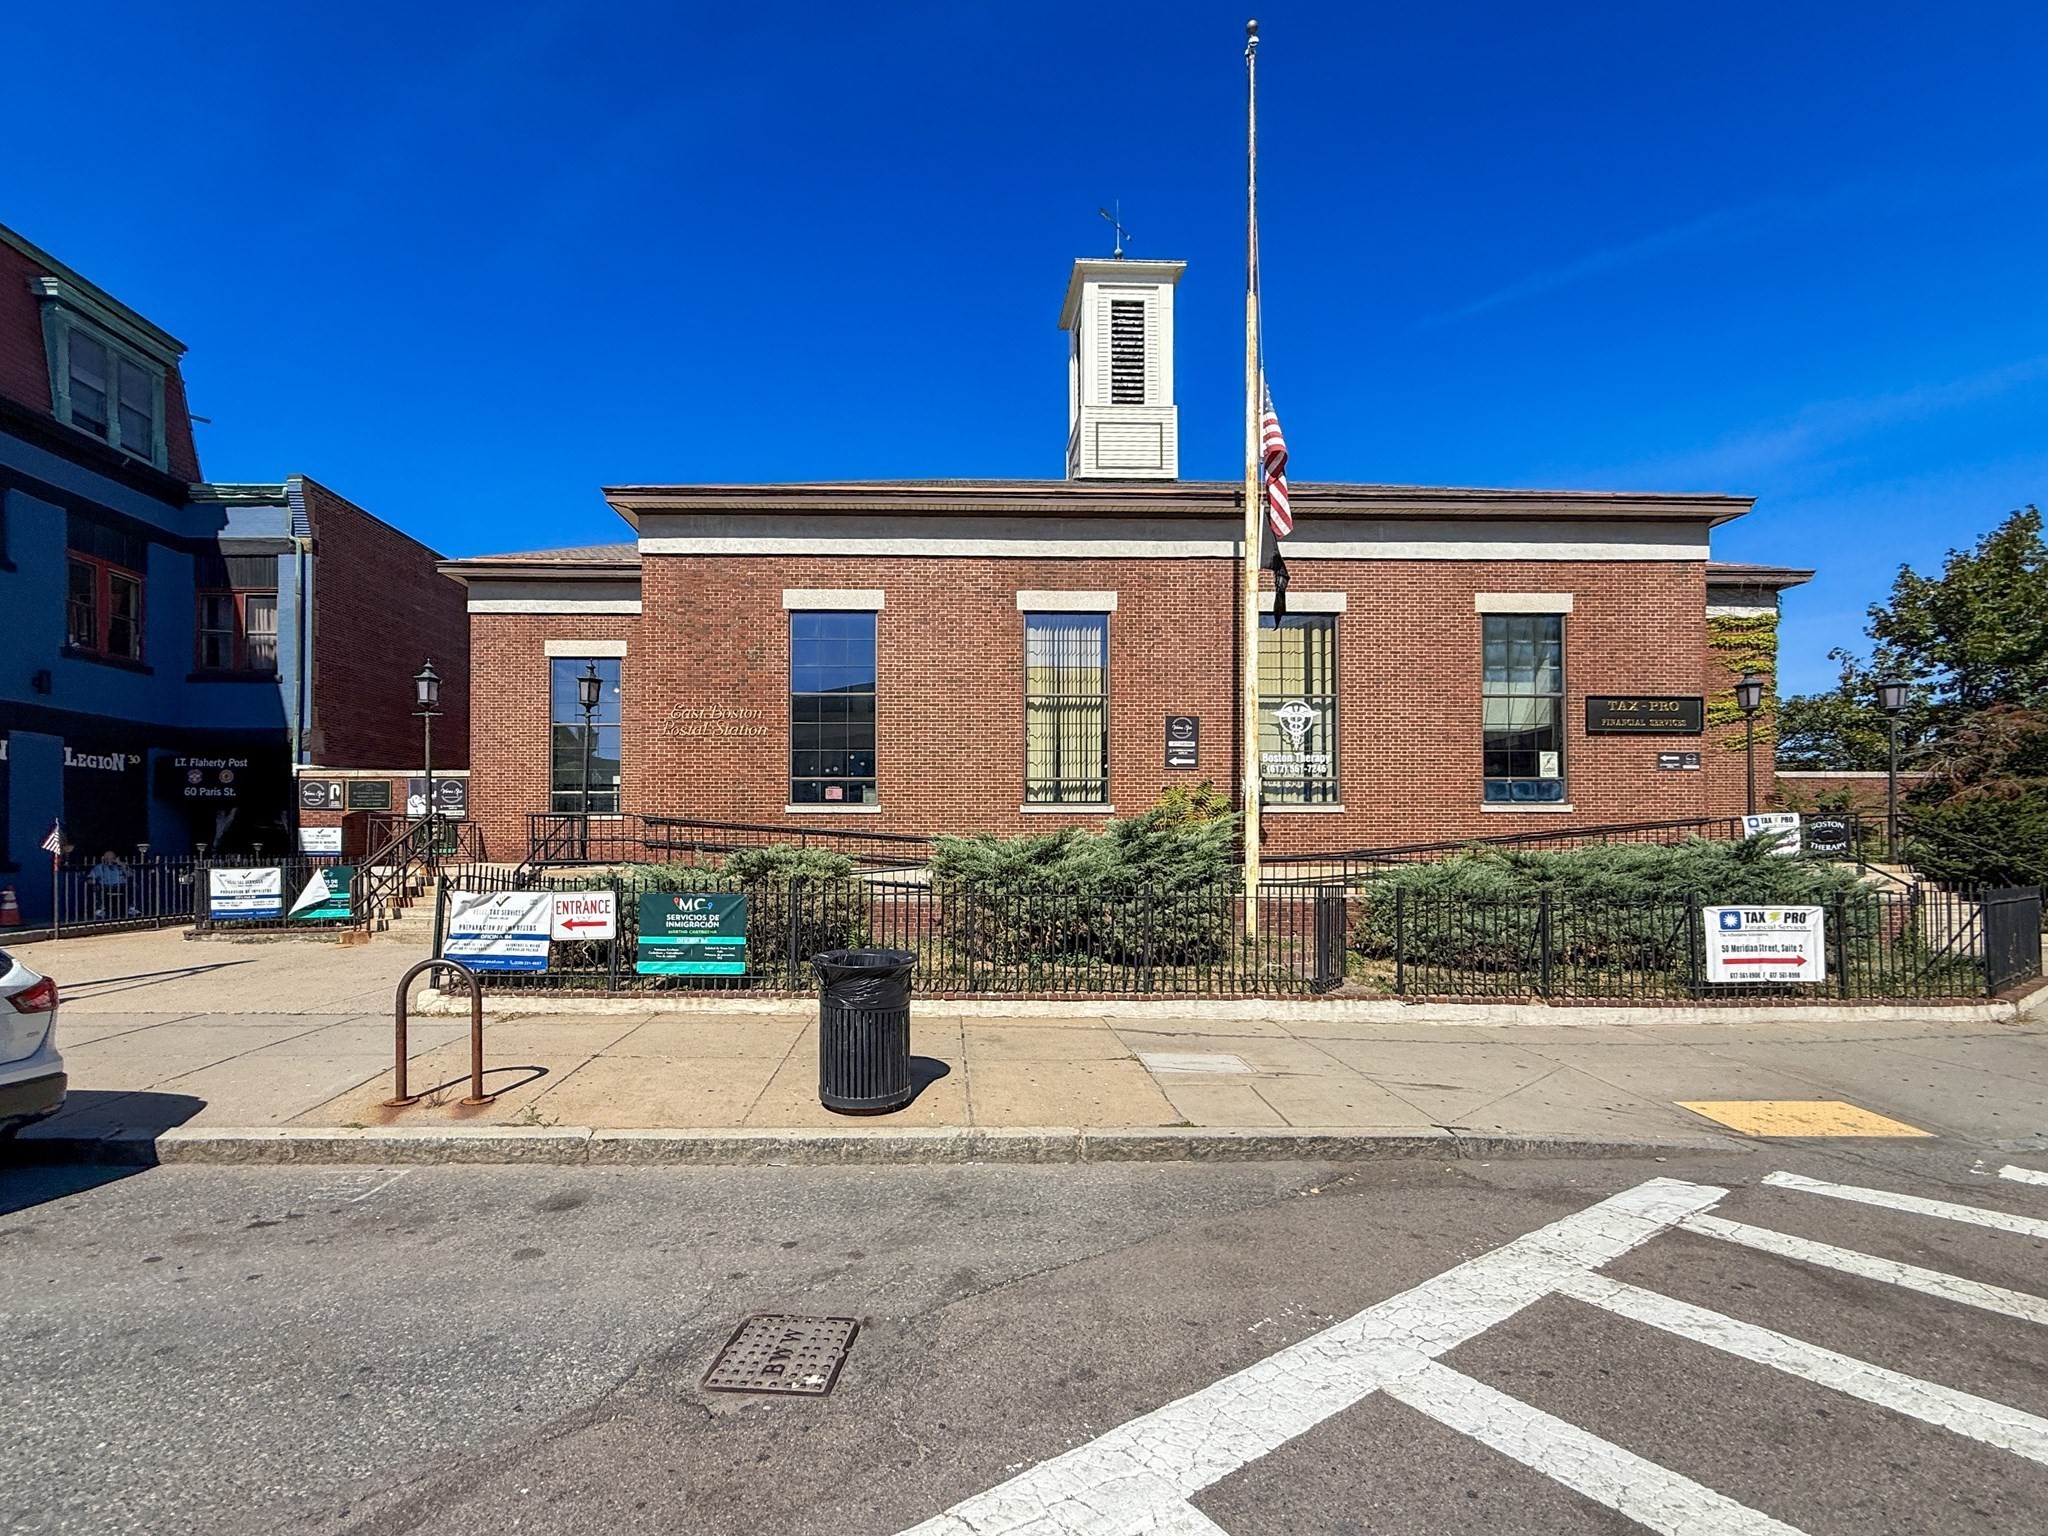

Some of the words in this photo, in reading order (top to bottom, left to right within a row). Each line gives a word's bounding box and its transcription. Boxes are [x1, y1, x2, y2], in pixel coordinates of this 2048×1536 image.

[670, 702, 706, 720] East
[710, 703, 763, 720] Boston
[1601, 718, 1646, 727] FINANCIAL
[1649, 718, 1687, 727] SERVICES
[662, 720, 710, 737] Postal
[713, 720, 769, 737] Station
[189, 757, 227, 769] Flaherty
[228, 758, 248, 768] Post
[1262, 752, 1293, 763] Boston
[1294, 752, 1330, 764] Therapy
[1266, 764, 1288, 774] (617)
[184, 787, 198, 797] 60
[199, 787, 222, 797] Paris
[223, 787, 237, 797] St.
[1760, 817, 1773, 825] TAX
[1780, 816, 1794, 824] PRO
[1810, 840, 1847, 851] THERAPY
[555, 899, 611, 915] ENTRANCE
[679, 897, 707, 911] MC
[665, 913, 707, 921] SERVICIOS
[708, 913, 720, 921] DE
[1743, 911, 1766, 924] TAX
[1783, 911, 1807, 924] PRO
[1721, 944, 1730, 953] 50
[1730, 944, 1758, 952] Meridian
[1758, 944, 1780, 953] Street,
[1781, 944, 1797, 952] Suite
[1798, 944, 1804, 952] 2
